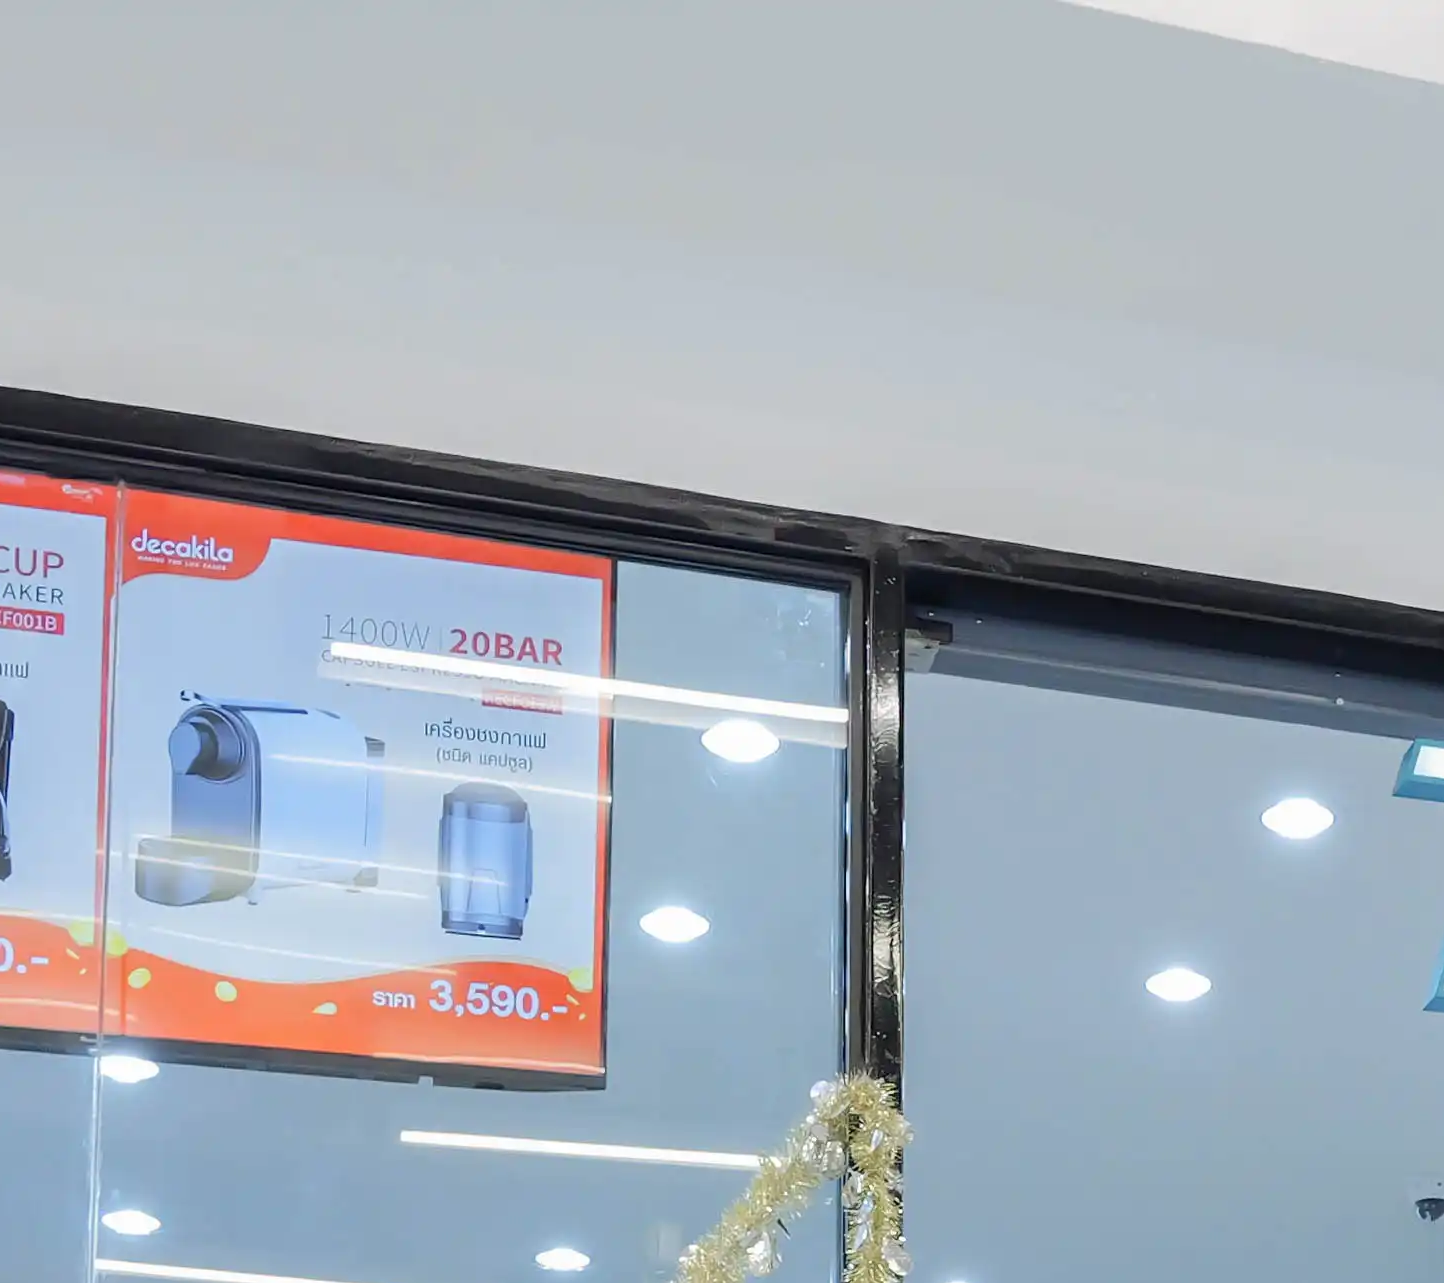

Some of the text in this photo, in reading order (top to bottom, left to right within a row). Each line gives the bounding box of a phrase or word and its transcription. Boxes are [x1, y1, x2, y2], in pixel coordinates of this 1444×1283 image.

[131, 529, 233, 562] decakila
[321, 614, 563, 666] 1400W 20BAR
[424, 719, 547, 750] เครื่องชงกาแฟ
[373, 979, 569, 1021] ราคา 3,590.-
